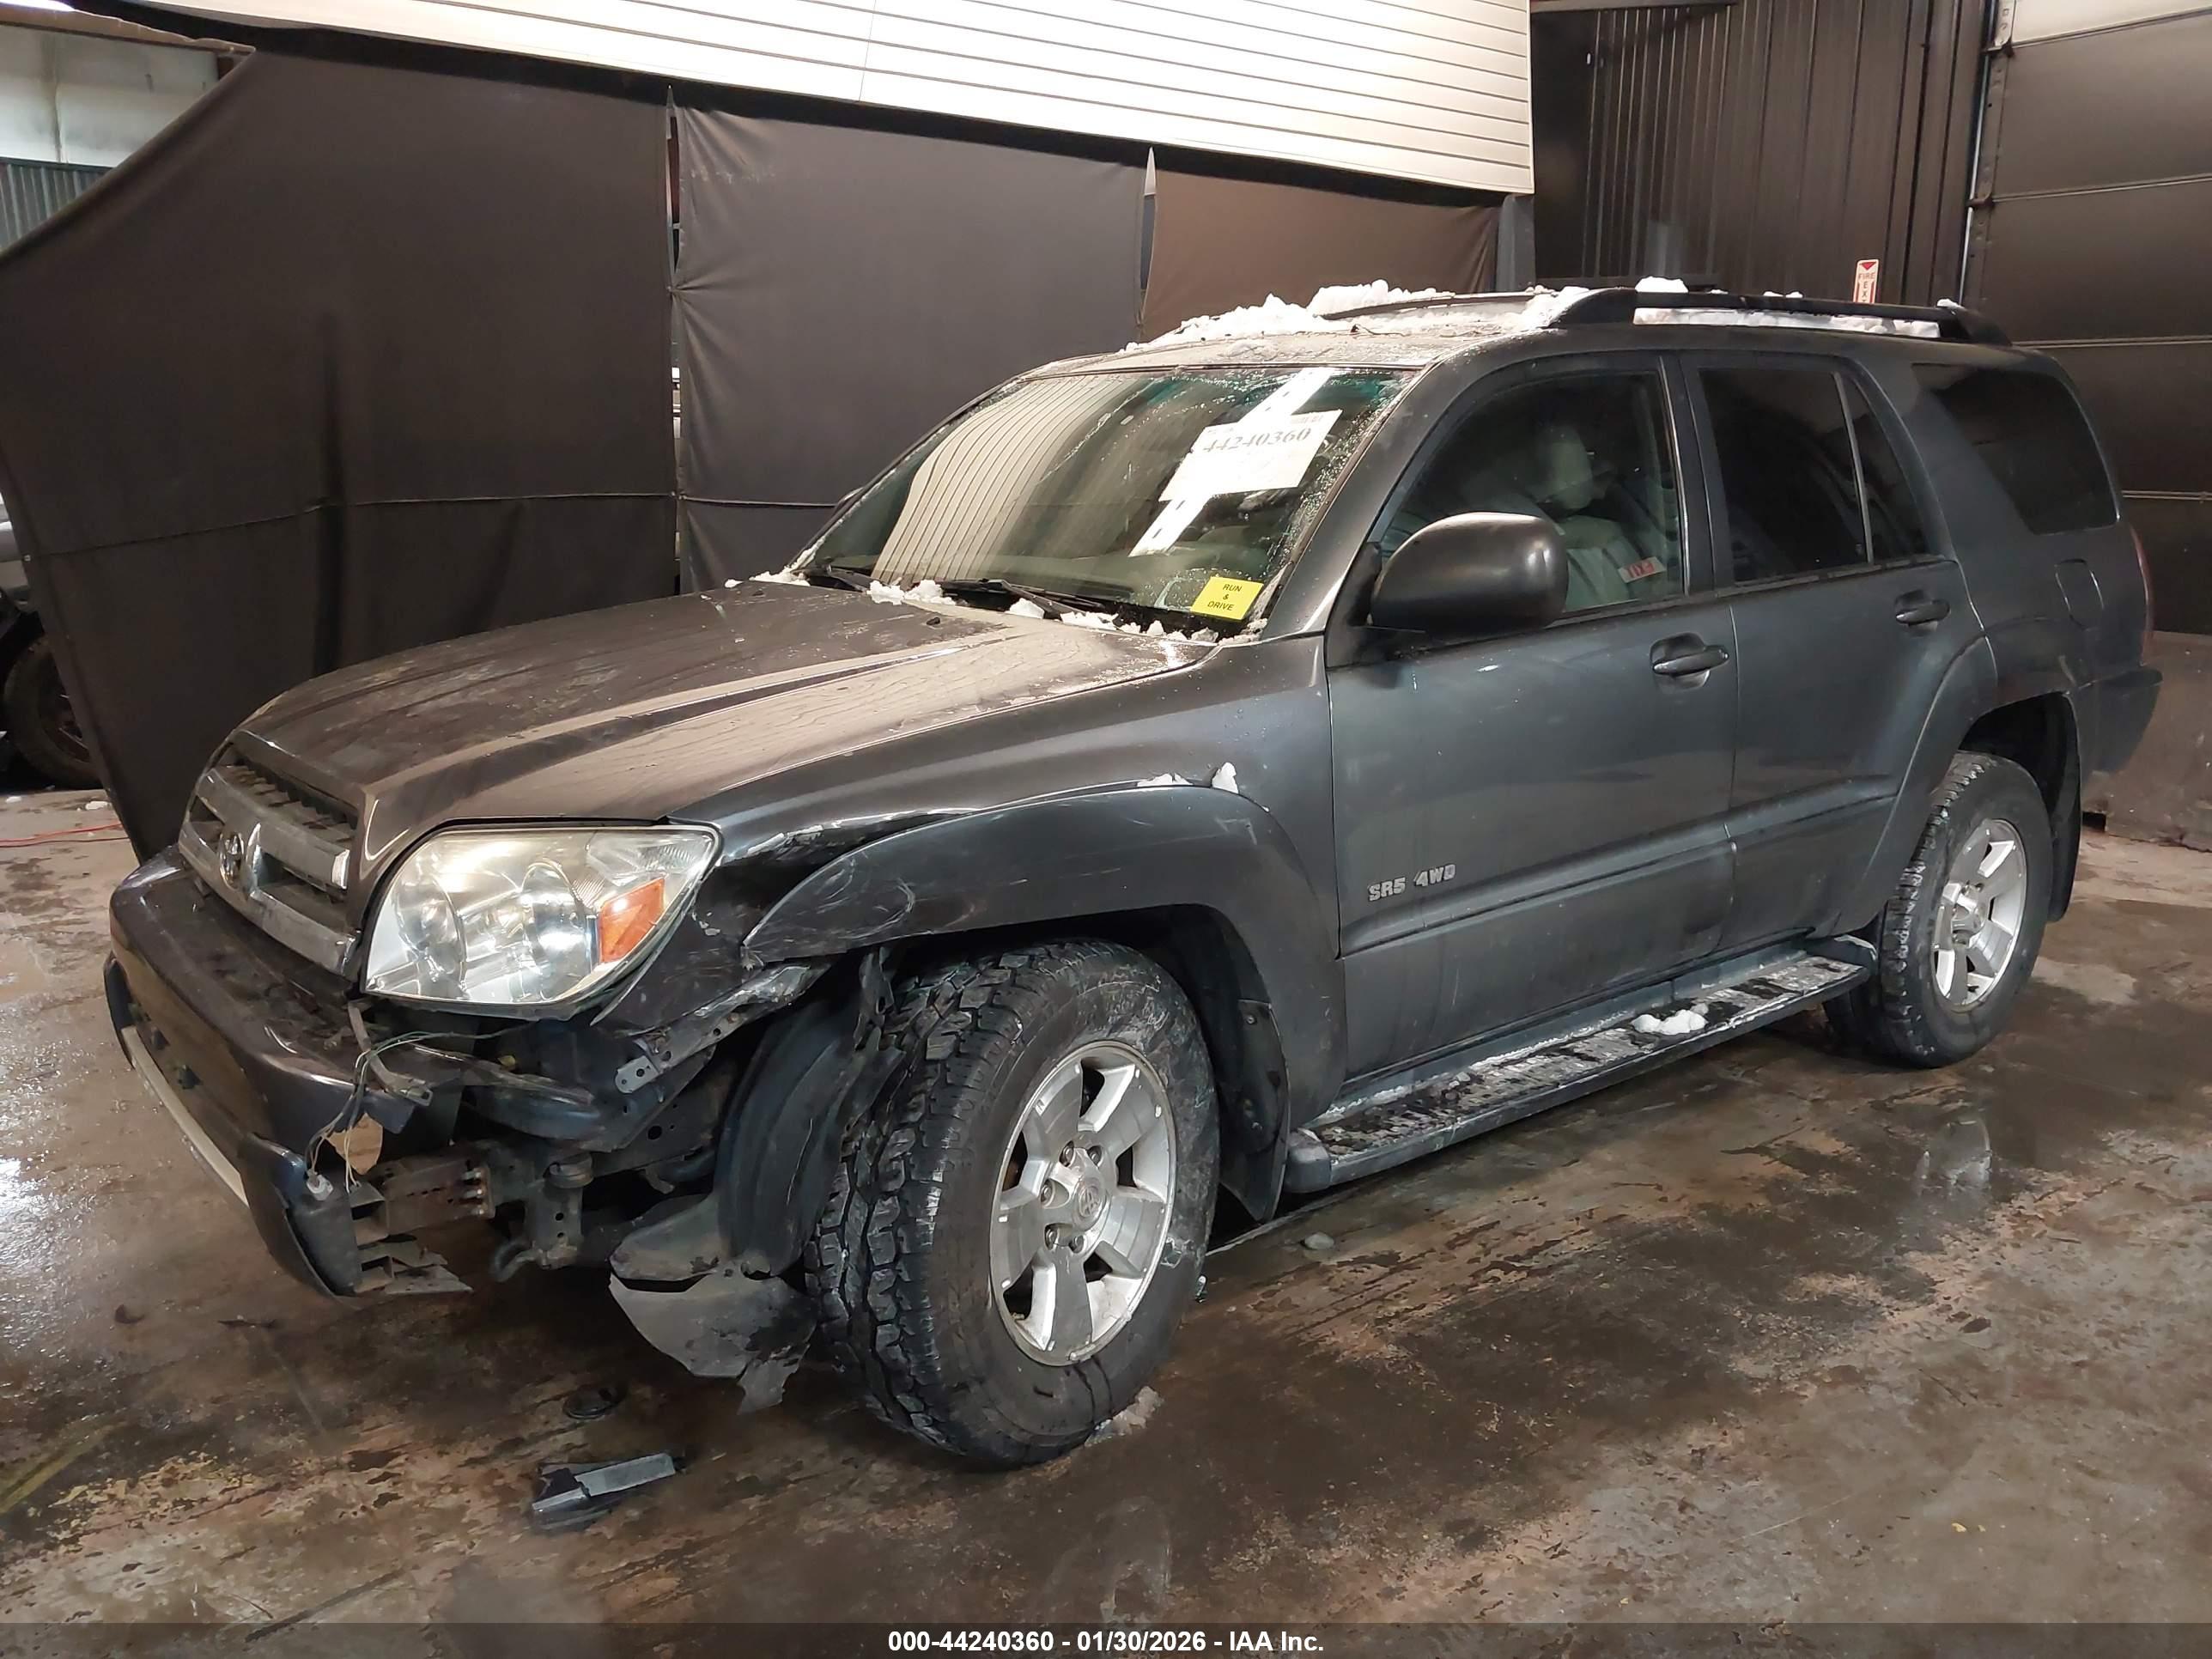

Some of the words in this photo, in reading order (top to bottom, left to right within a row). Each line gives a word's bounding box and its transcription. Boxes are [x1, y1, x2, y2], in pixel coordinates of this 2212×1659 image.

[1202, 428, 1312, 453] 44240360
[1222, 583, 1243, 592] RUN
[1206, 601, 1234, 611] DRIVE
[1367, 877, 1406, 901] SR5
[1413, 864, 1455, 886] 4WD
